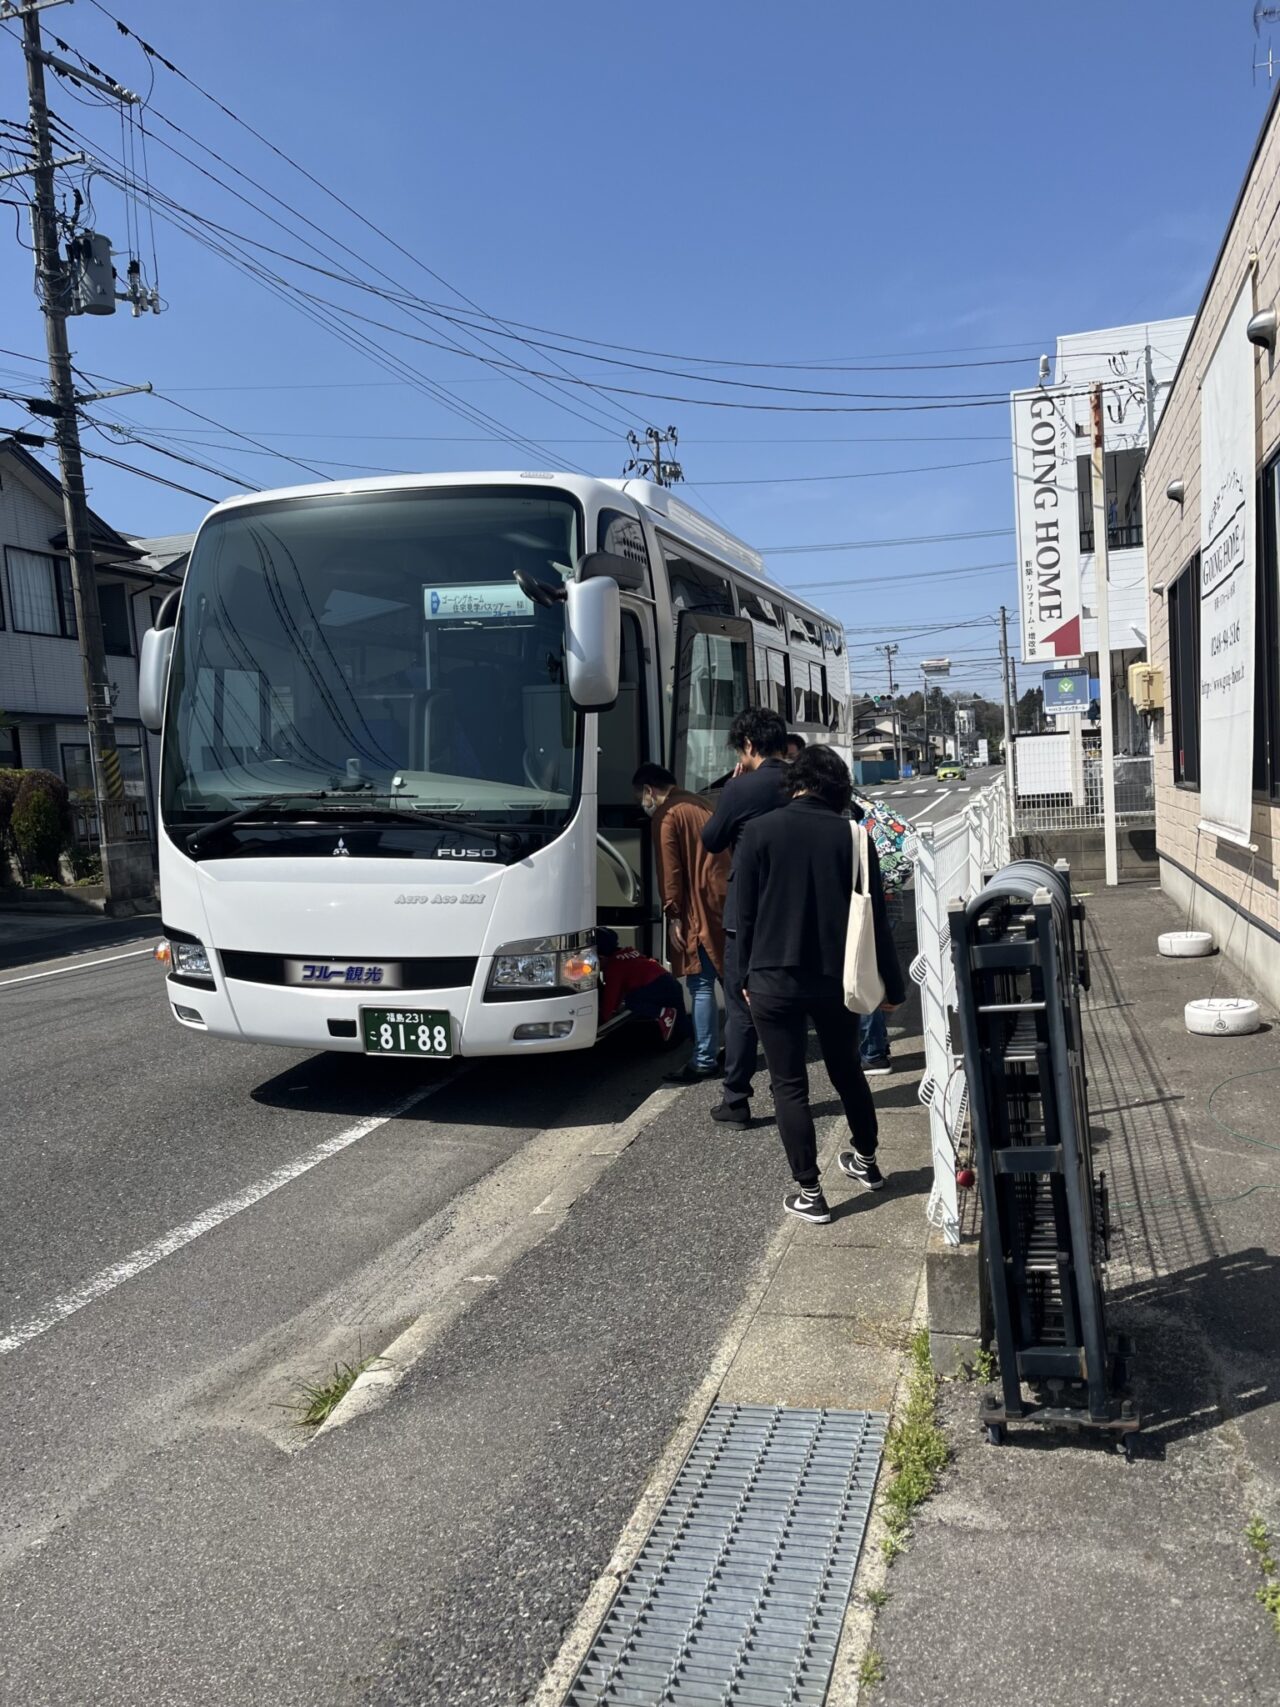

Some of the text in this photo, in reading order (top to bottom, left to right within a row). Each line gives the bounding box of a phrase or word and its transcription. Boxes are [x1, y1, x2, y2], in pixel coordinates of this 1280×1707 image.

[1031, 396, 1062, 622] GOING HOME
[1203, 545, 1223, 586] GOING
[1223, 525, 1240, 568] HOME
[437, 848, 497, 858] FUSO
[394, 894, 486, 905] Aero Ace MM
[380, 1023, 447, 1052] 81-88
